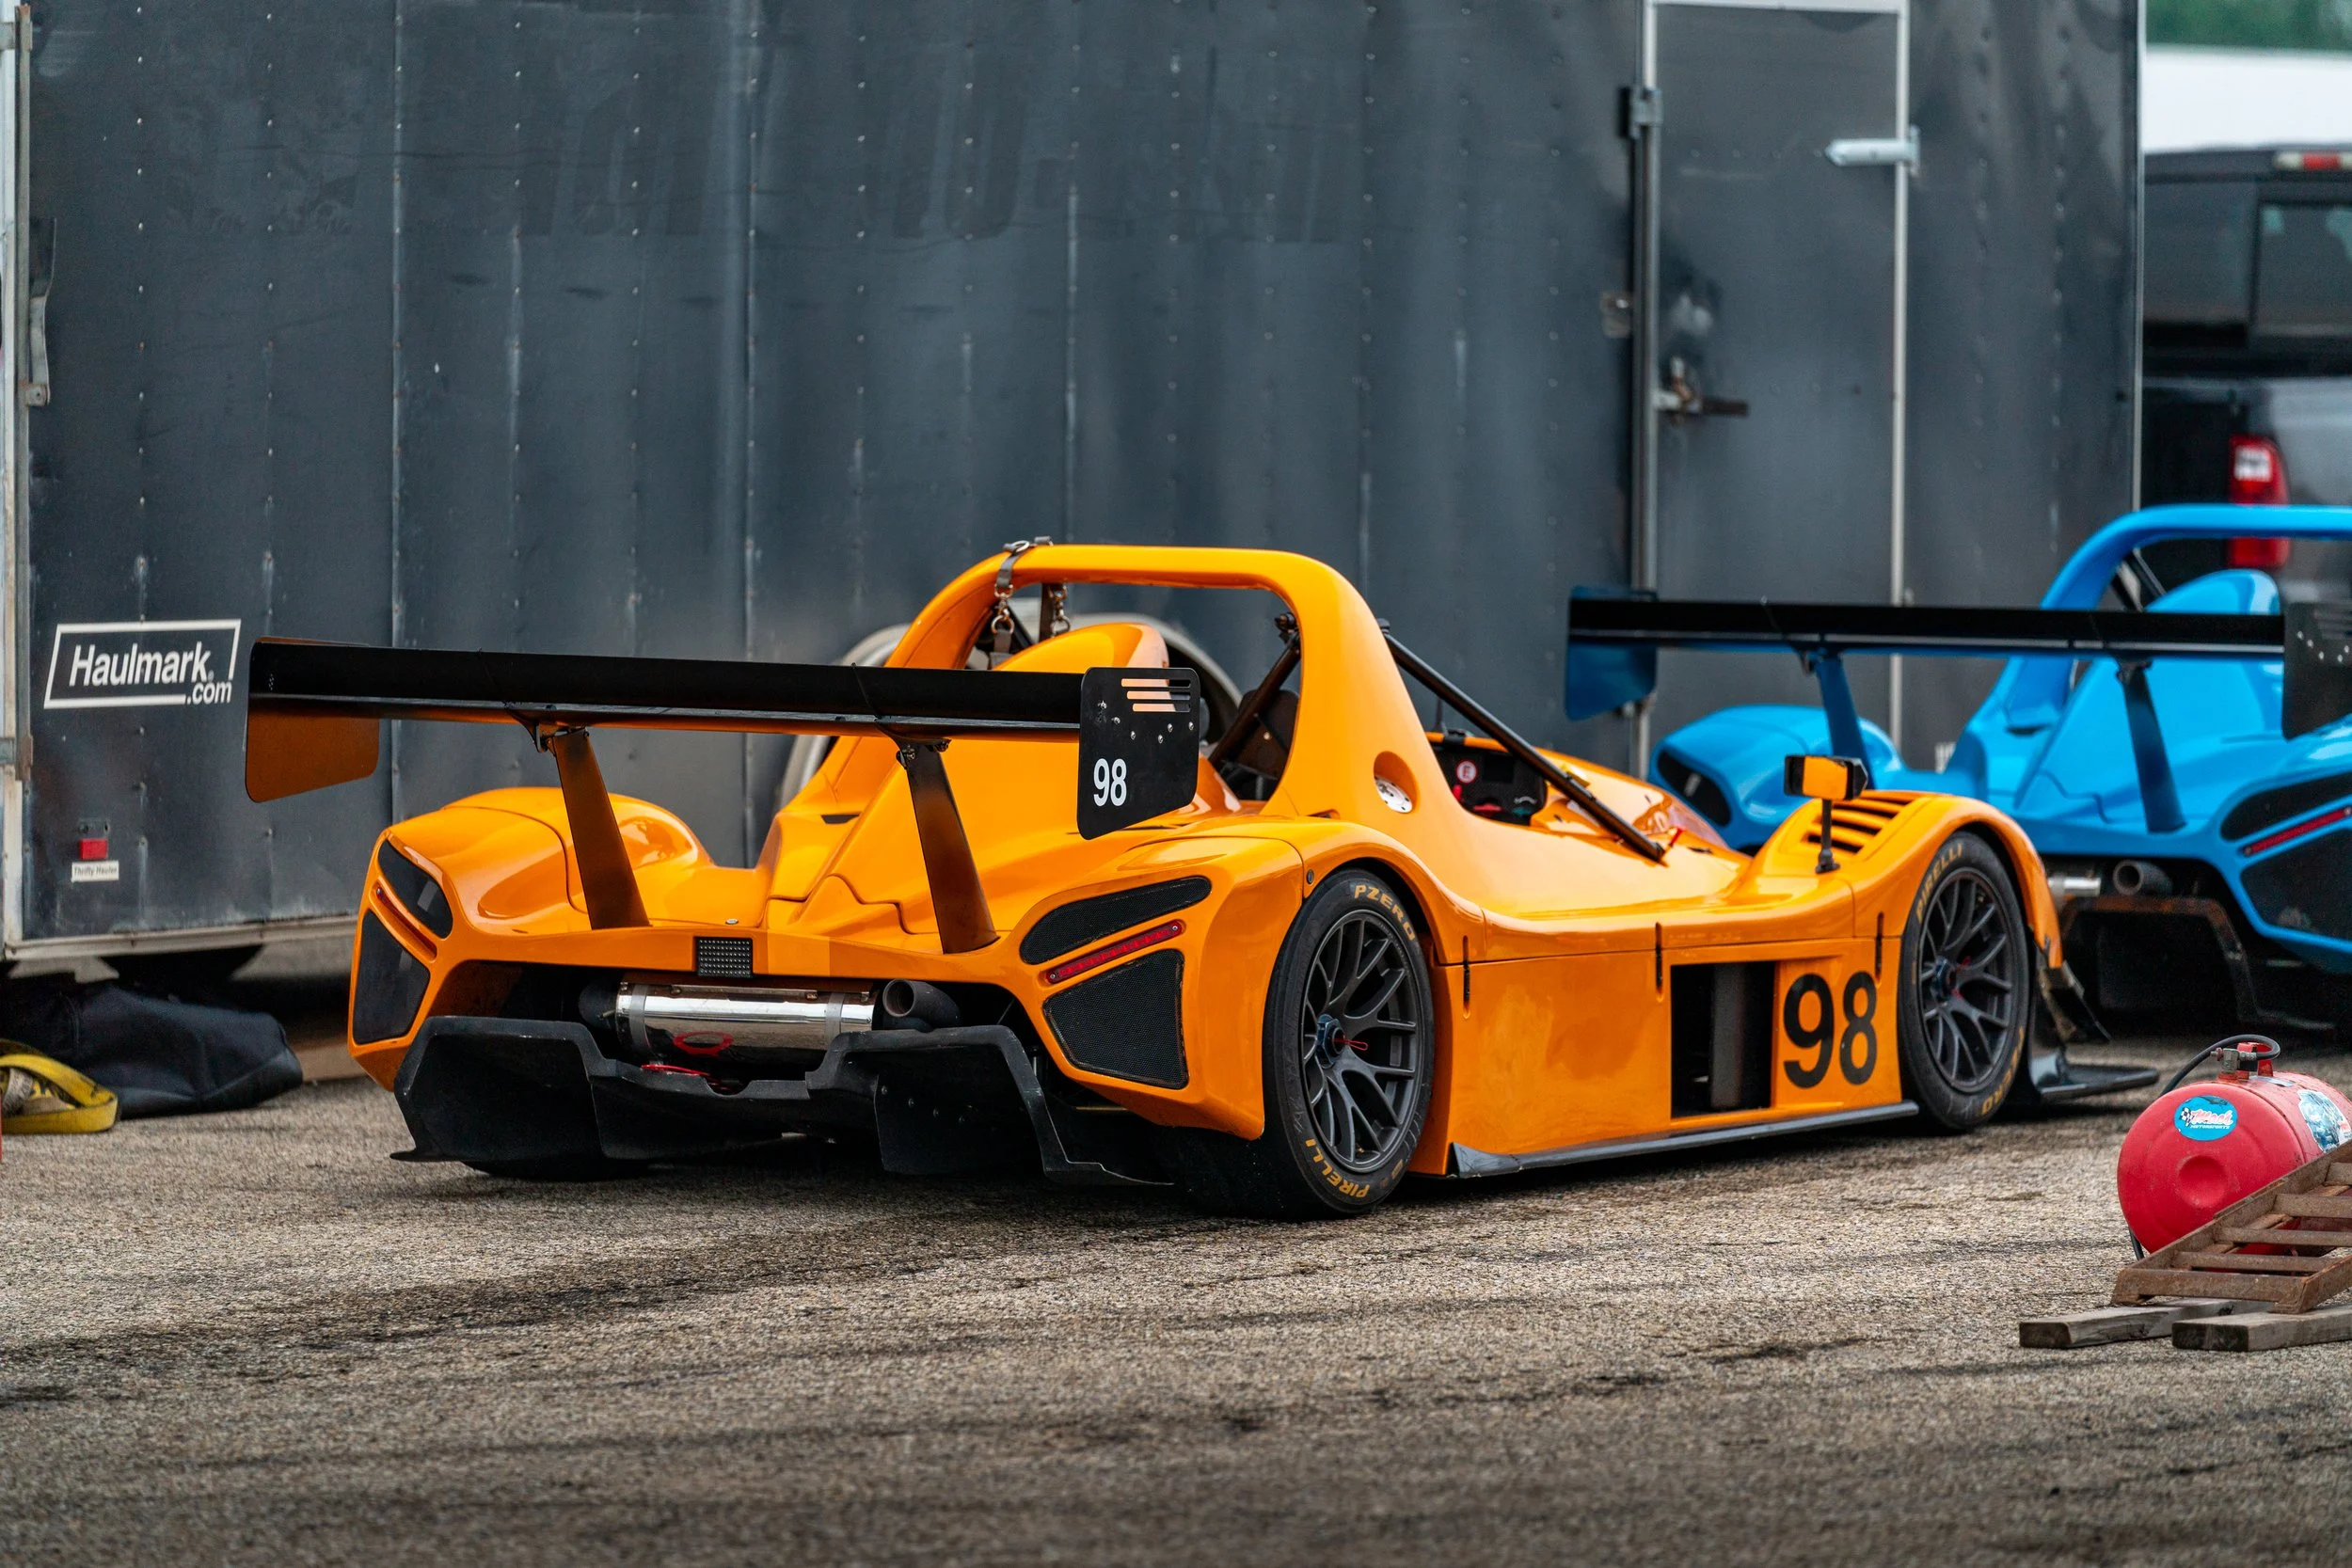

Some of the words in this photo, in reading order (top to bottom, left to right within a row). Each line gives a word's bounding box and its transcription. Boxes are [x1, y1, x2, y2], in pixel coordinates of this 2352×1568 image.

[69, 641, 212, 687] Haulmark
[186, 681, 232, 705] .com
[1093, 758, 1127, 807] 98
[1916, 843, 1963, 924] PIRELLI
[1355, 884, 1415, 941] PZERO
[1783, 971, 1878, 1089] 98
[1305, 1138, 1370, 1197] PIRELLI
